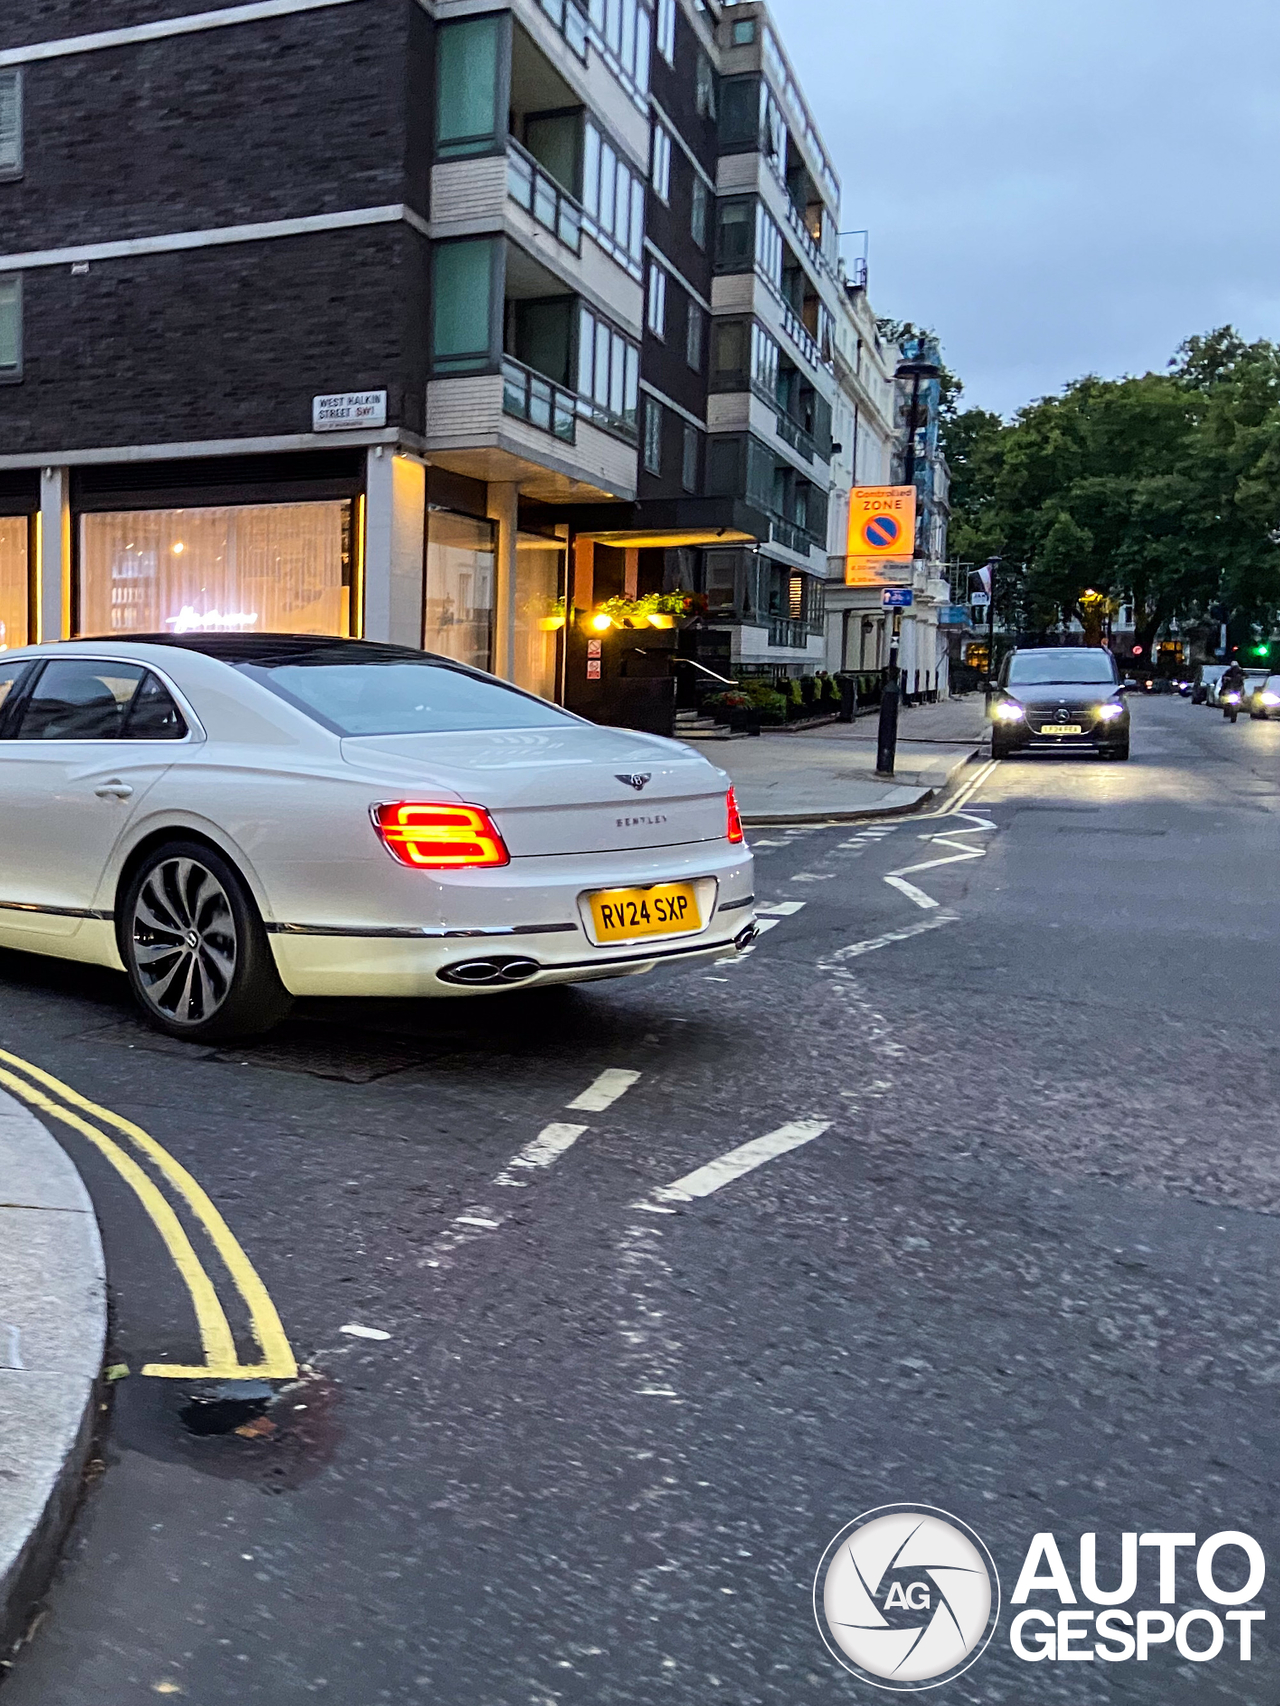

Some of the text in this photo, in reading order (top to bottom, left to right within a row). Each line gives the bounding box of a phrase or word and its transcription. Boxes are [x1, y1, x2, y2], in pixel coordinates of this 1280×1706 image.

[320, 394, 381, 408] WEST HALKIN
[319, 406, 375, 420] STREET SW1
[855, 488, 913, 499] Controlled
[863, 499, 903, 511] ZONE
[616, 815, 668, 828] BENTLEY
[600, 895, 688, 929] RV24 SXP
